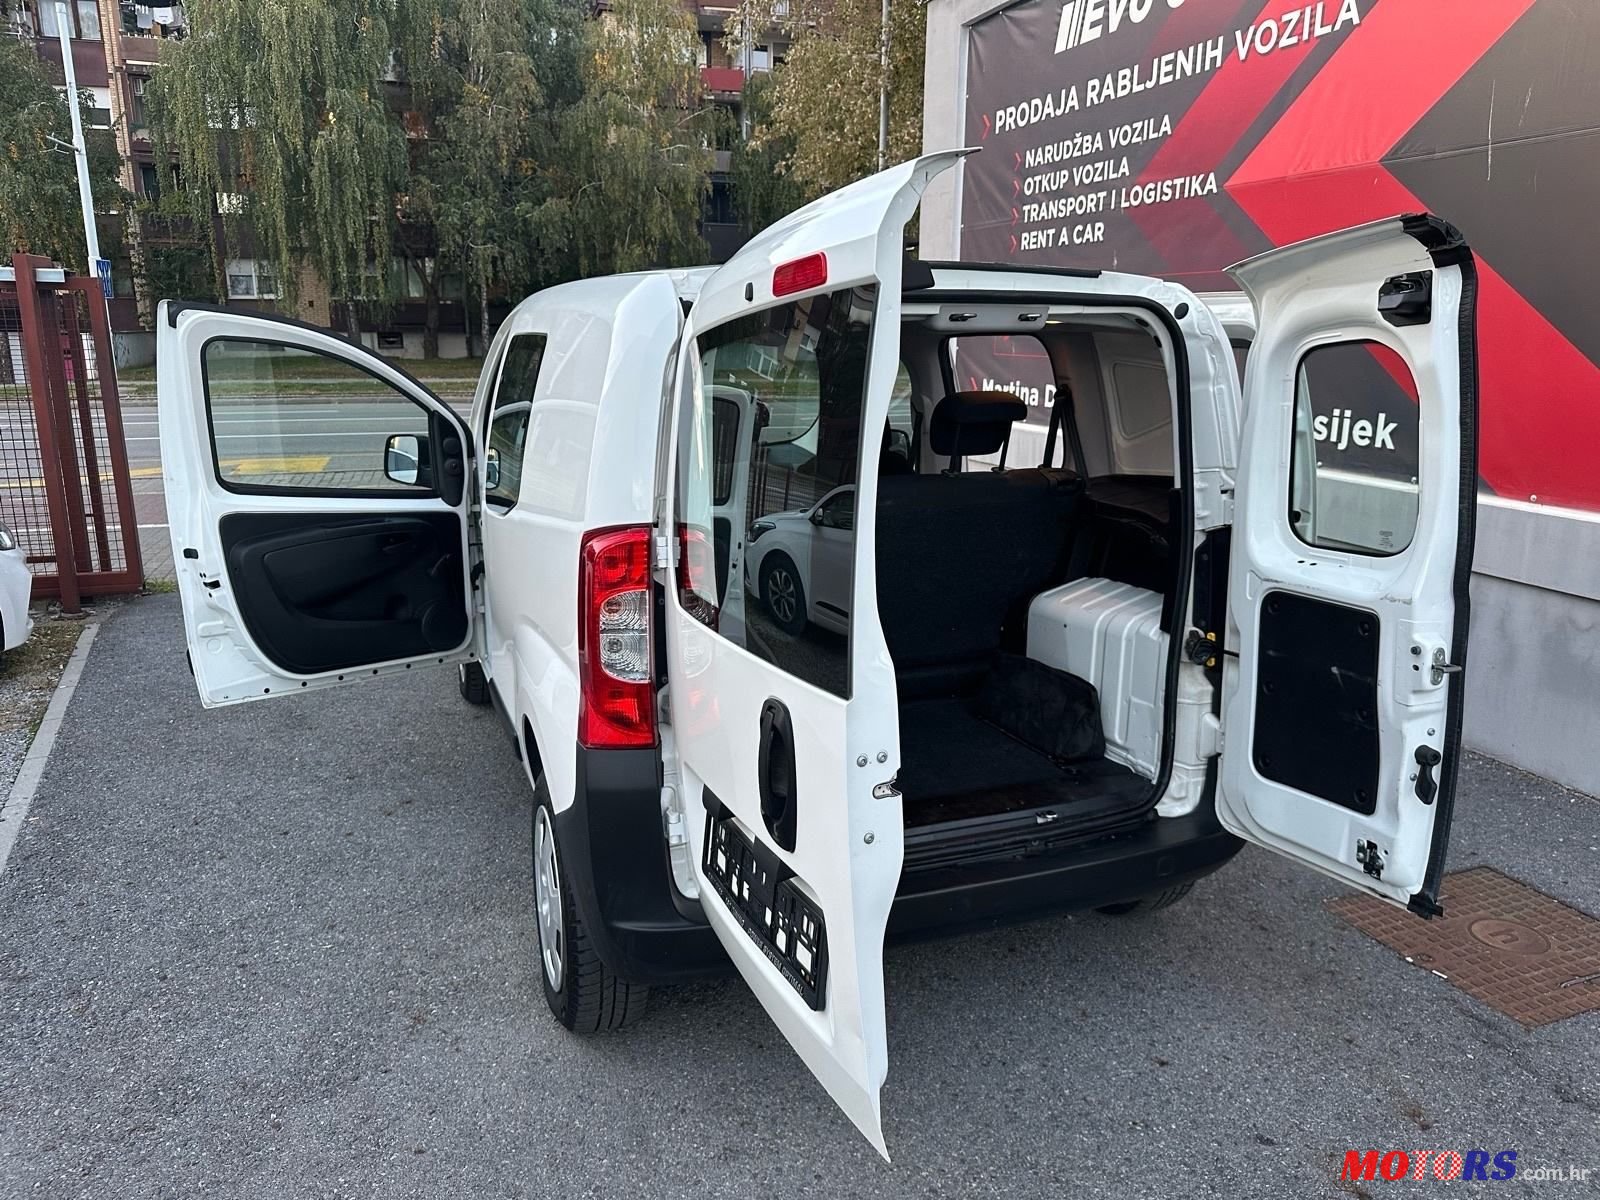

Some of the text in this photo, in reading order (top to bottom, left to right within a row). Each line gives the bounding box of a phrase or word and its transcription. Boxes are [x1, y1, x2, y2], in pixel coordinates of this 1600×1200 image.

[995, 0, 1361, 134] PRODAJA RABLJENIH VOZILA
[1025, 114, 1172, 168] NARUDŽBA VOZILA
[1022, 172, 1218, 223] TRANSPORT I LOGISTIKA
[1023, 156, 1130, 195] OTKUP VOZILA
[1020, 222, 1105, 250] RENT A CAR
[1313, 408, 1398, 450] sijek
